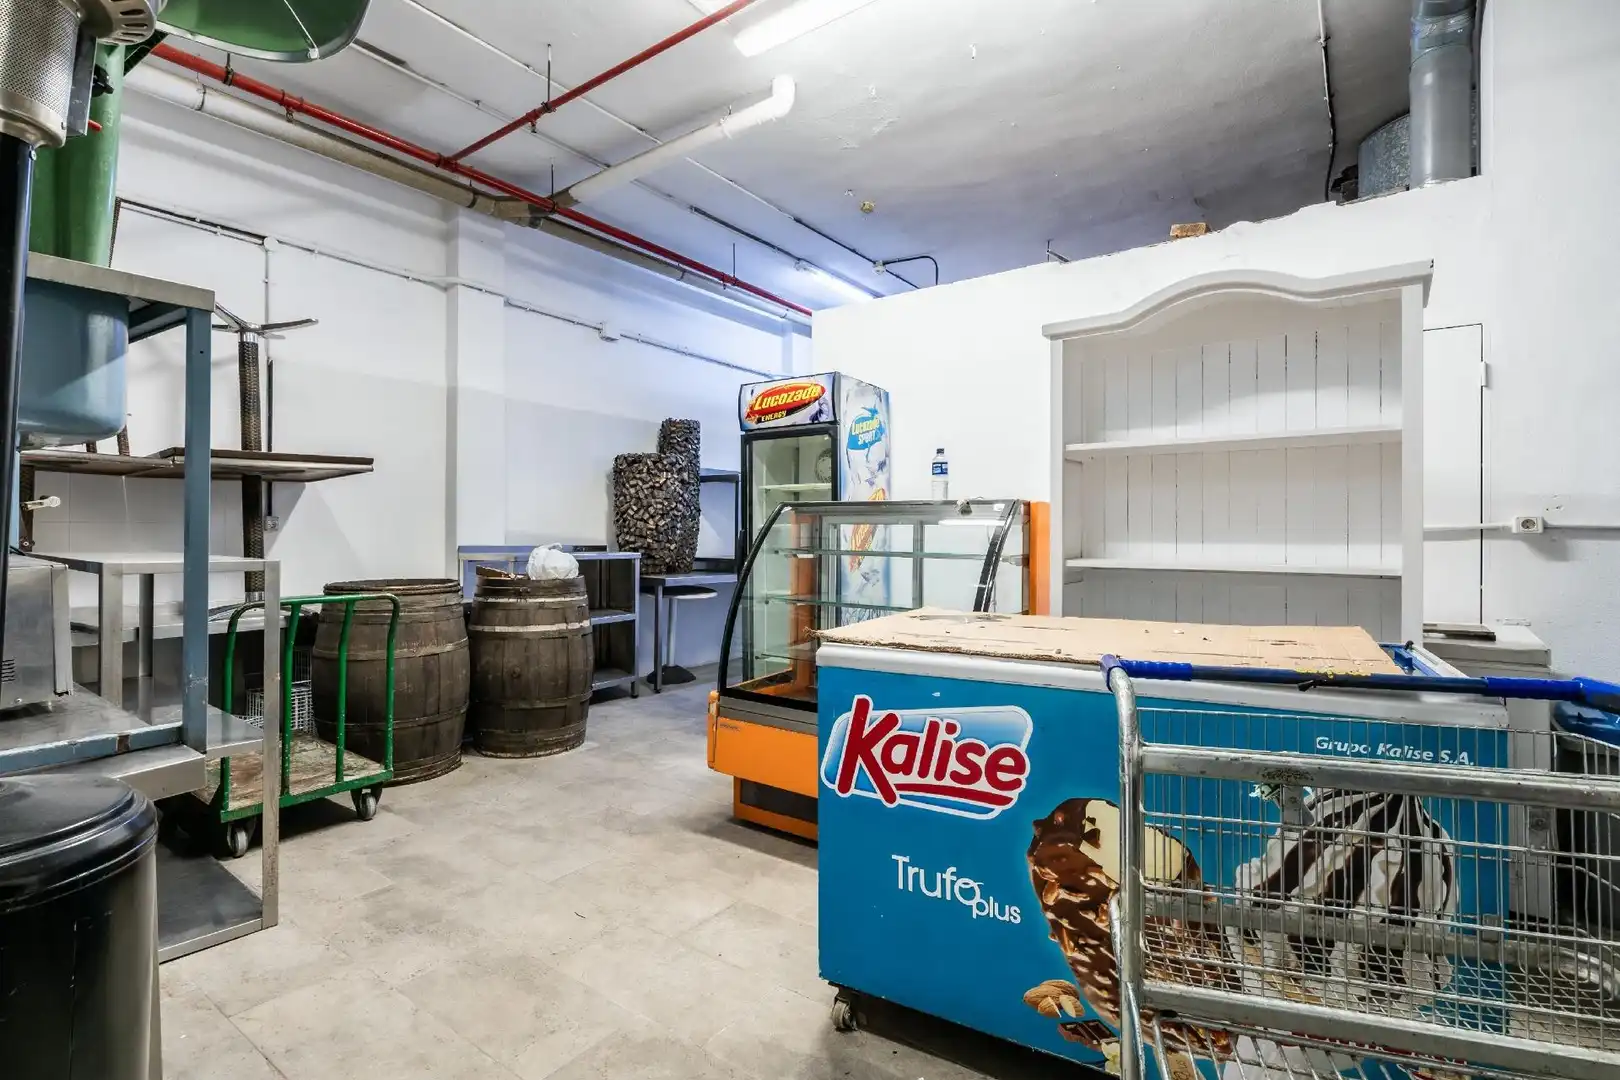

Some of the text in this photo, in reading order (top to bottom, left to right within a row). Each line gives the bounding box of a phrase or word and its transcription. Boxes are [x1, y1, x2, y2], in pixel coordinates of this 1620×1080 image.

[754, 384, 821, 410] Lucozade
[761, 410, 787, 422] ENERGY
[837, 698, 1027, 805] Kalise
[1315, 736, 1371, 755] Grupo
[1376, 742, 1434, 762] Kalise
[972, 896, 1021, 924] plus
